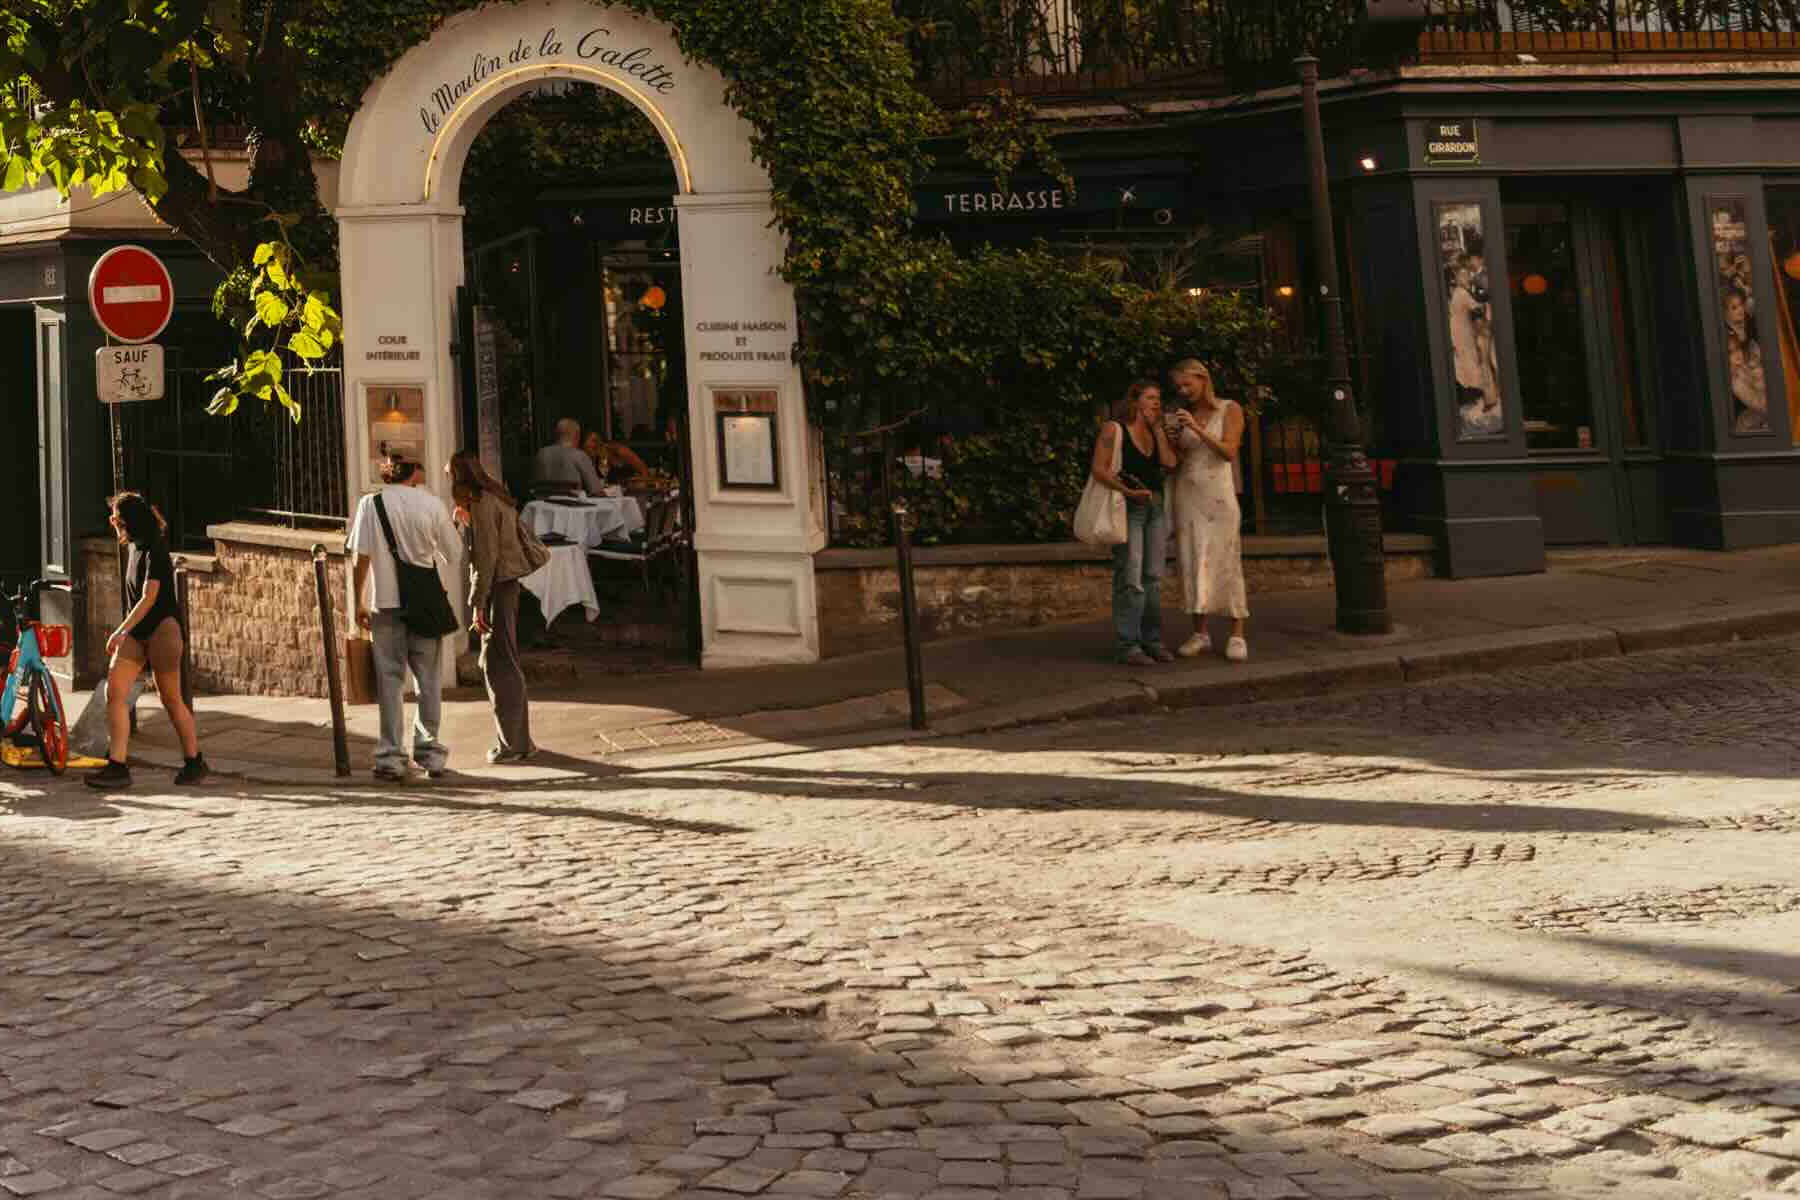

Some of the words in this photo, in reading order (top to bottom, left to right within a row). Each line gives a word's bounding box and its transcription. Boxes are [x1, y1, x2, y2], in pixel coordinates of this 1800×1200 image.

[431, 52, 502, 115] Moulin
[508, 38, 531, 64] de
[539, 27, 563, 57] la
[576, 28, 676, 95] Galette
[1440, 125, 1461, 137] RUE
[943, 190, 1064, 213] TERRASSE
[742, 321, 788, 332] MAISON
[735, 336, 748, 347] ET
[114, 350, 149, 364] SAUF
